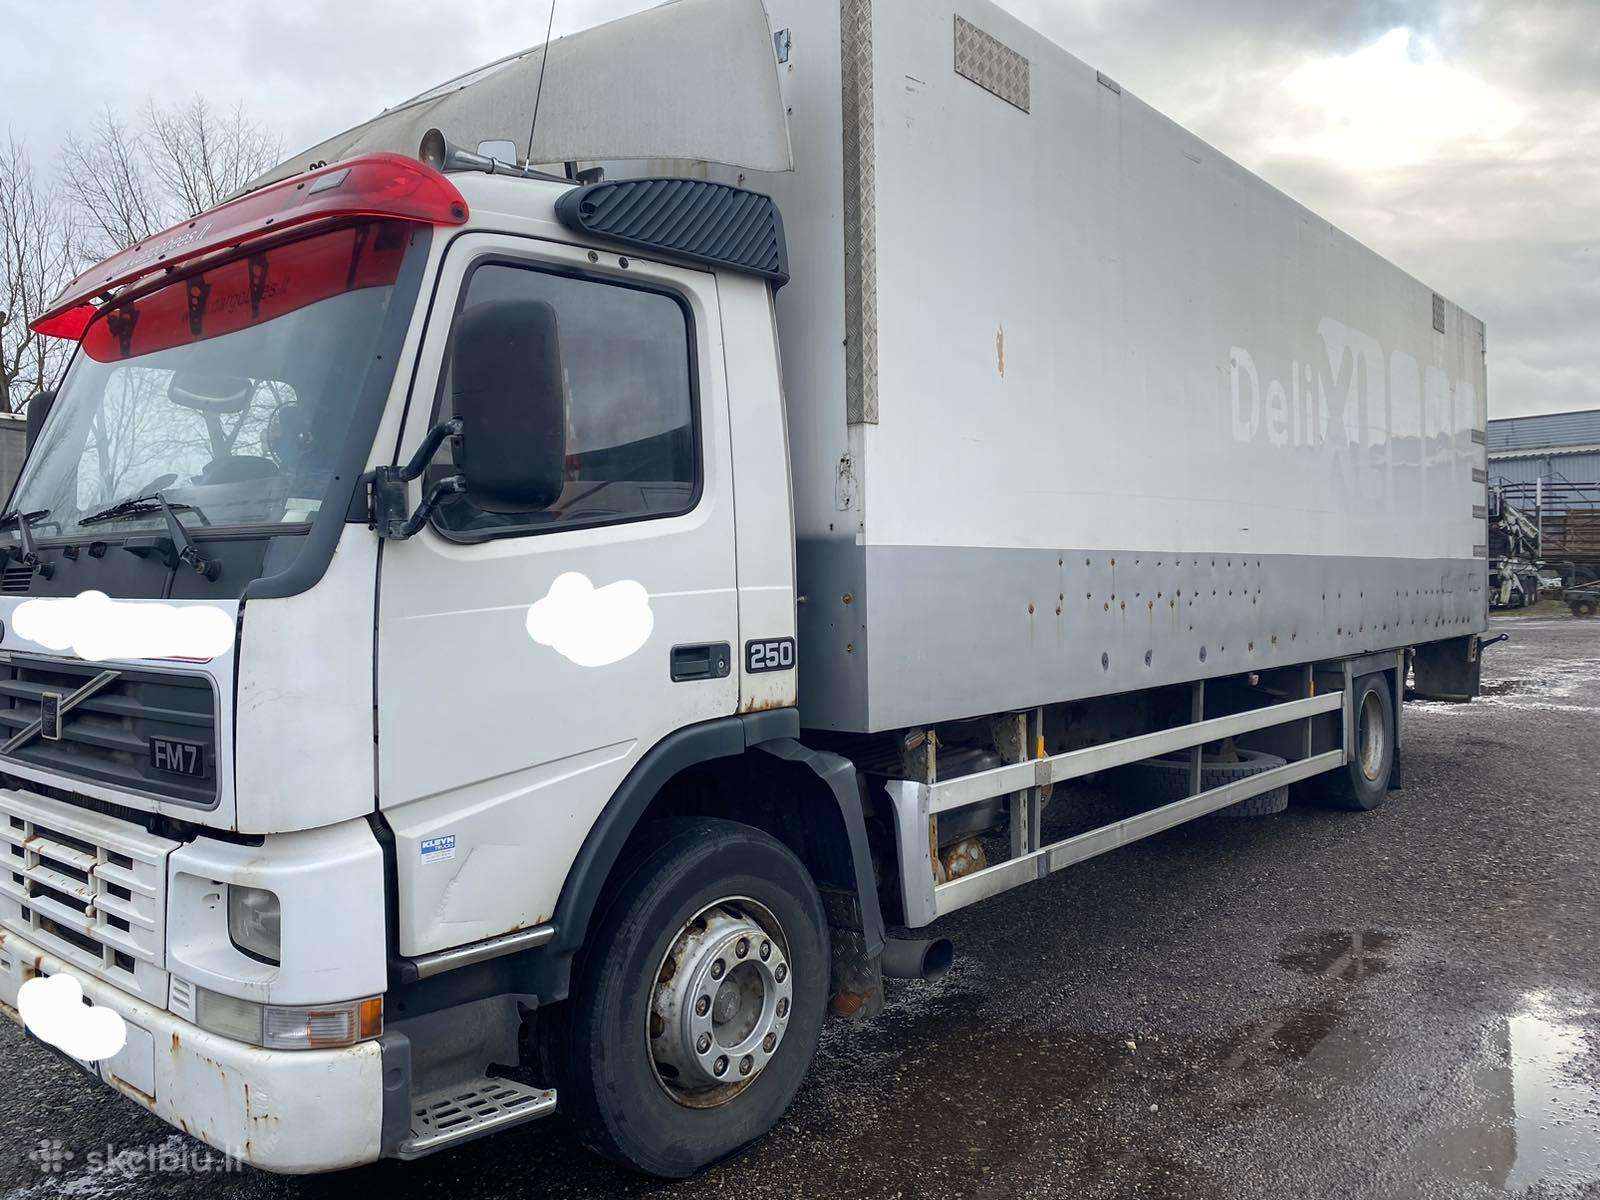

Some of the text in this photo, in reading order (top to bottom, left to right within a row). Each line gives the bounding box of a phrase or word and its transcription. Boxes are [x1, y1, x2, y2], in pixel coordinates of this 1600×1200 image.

[750, 641, 793, 669] 250
[154, 737, 198, 774] FM7
[422, 836, 454, 849] KLEYN
